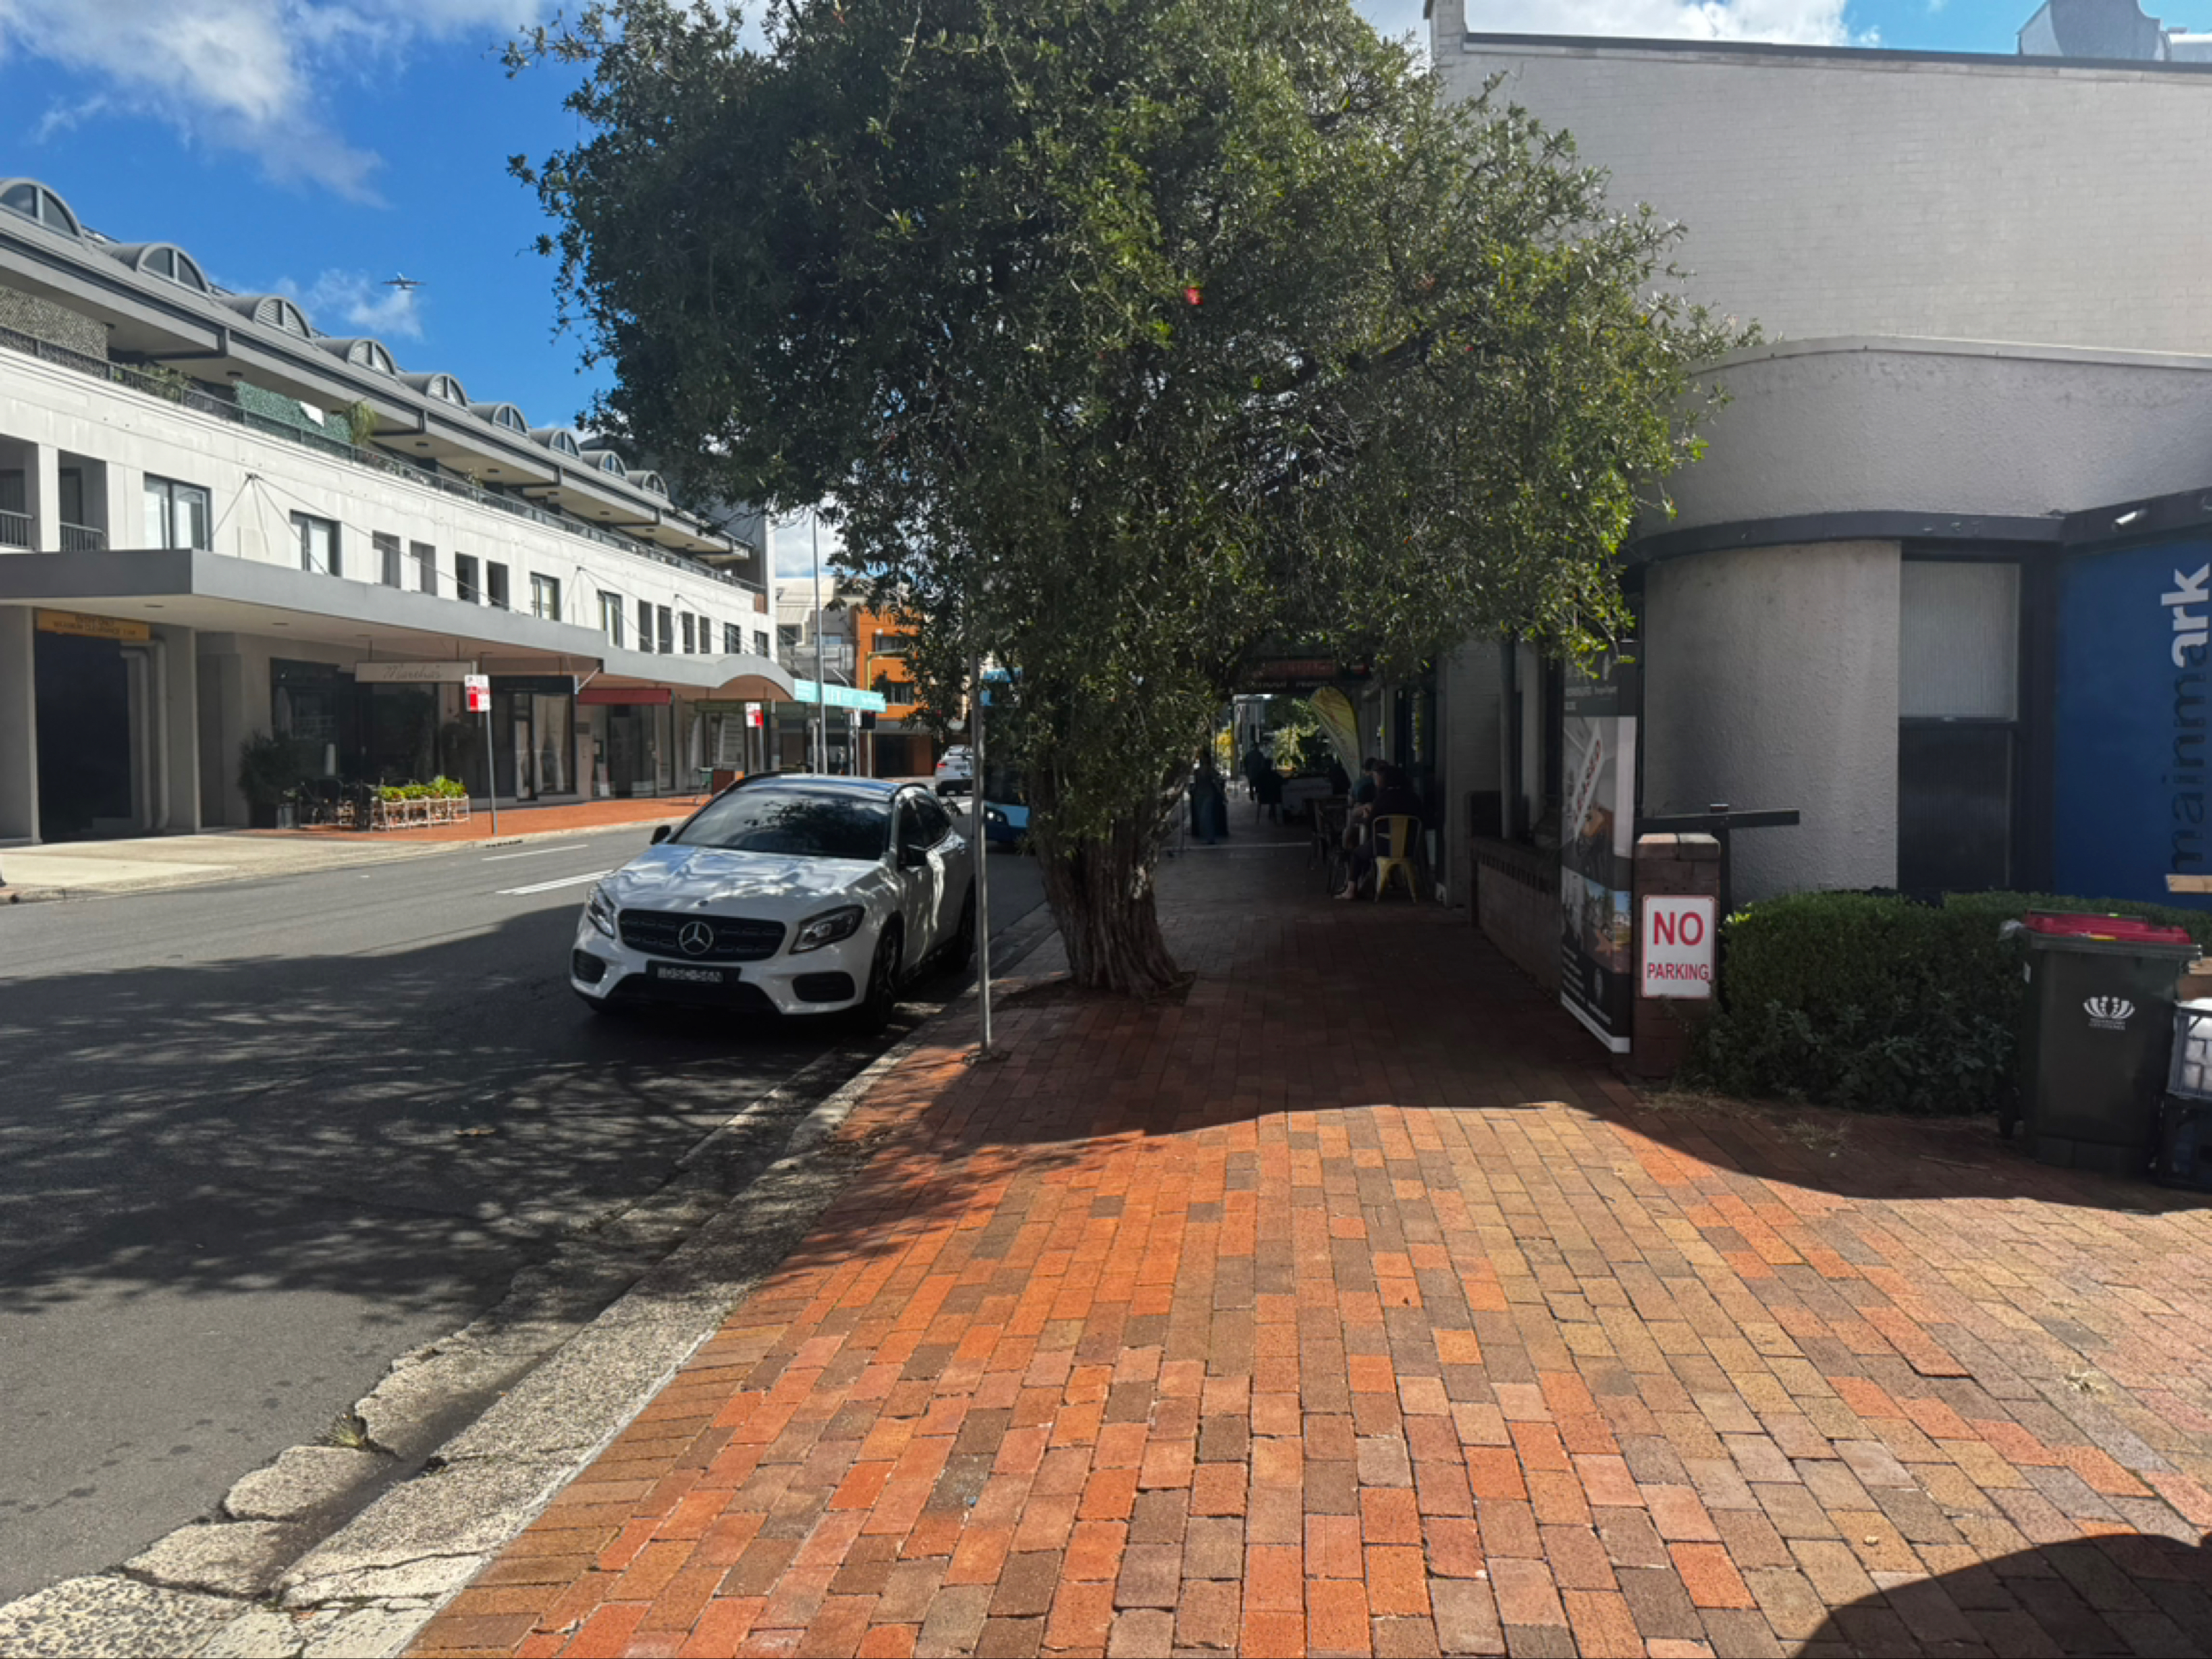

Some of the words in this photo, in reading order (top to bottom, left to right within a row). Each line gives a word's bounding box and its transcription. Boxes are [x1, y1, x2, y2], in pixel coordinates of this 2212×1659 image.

[2161, 563, 2211, 876] mainmark
[1654, 910, 1705, 947] NO
[1646, 962, 1709, 980] PARKING
